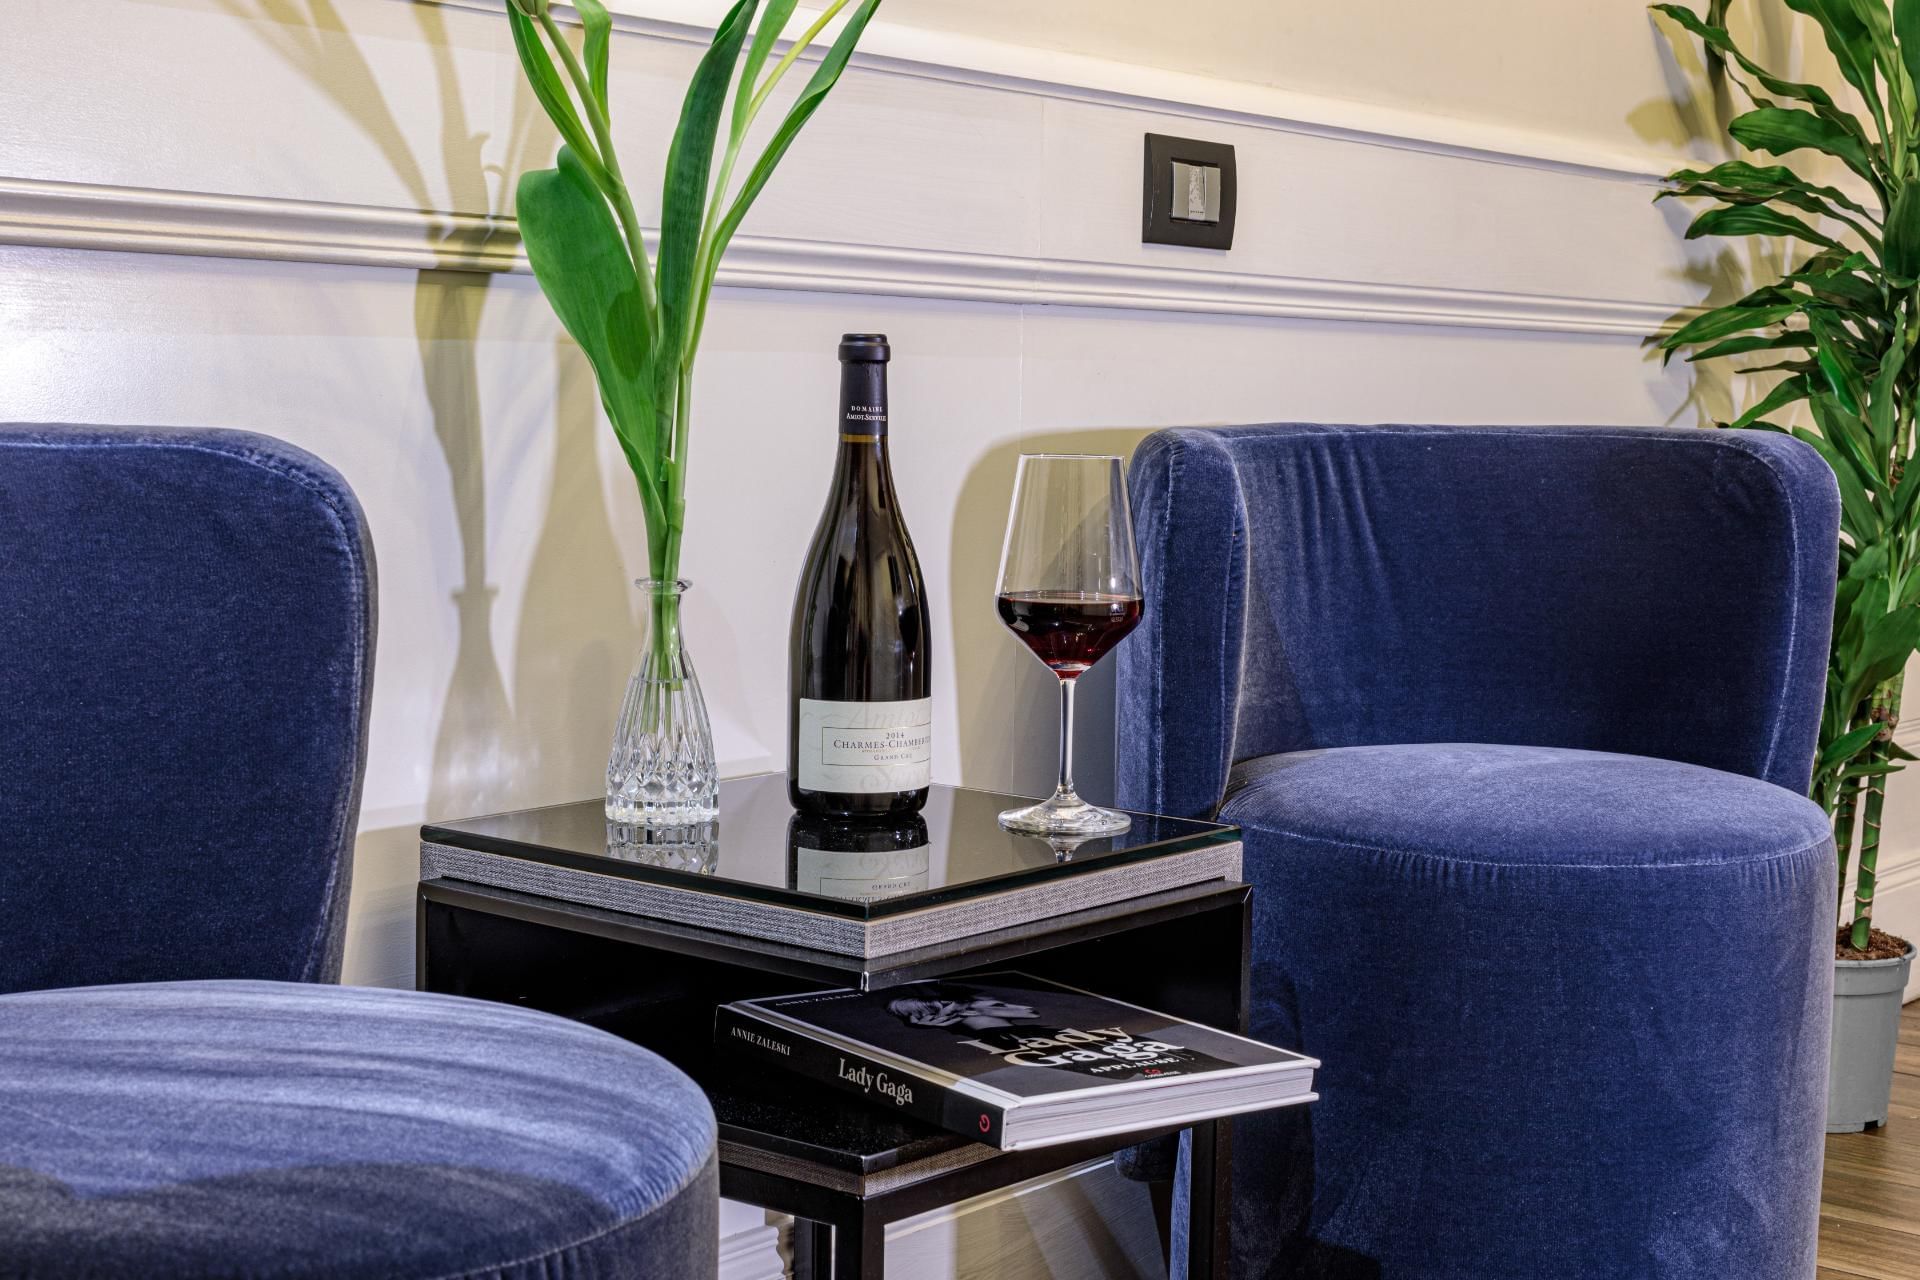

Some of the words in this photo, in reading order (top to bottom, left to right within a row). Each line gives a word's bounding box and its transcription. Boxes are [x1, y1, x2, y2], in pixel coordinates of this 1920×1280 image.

[886, 731, 905, 740] 2014
[730, 1026, 756, 1044] ANNIE
[756, 1034, 791, 1056] ZALESKI
[957, 1026, 1134, 1055] Lady
[1003, 1041, 1185, 1067] Gaga
[838, 1057, 874, 1093] Lady
[876, 1072, 913, 1106] Gaga
